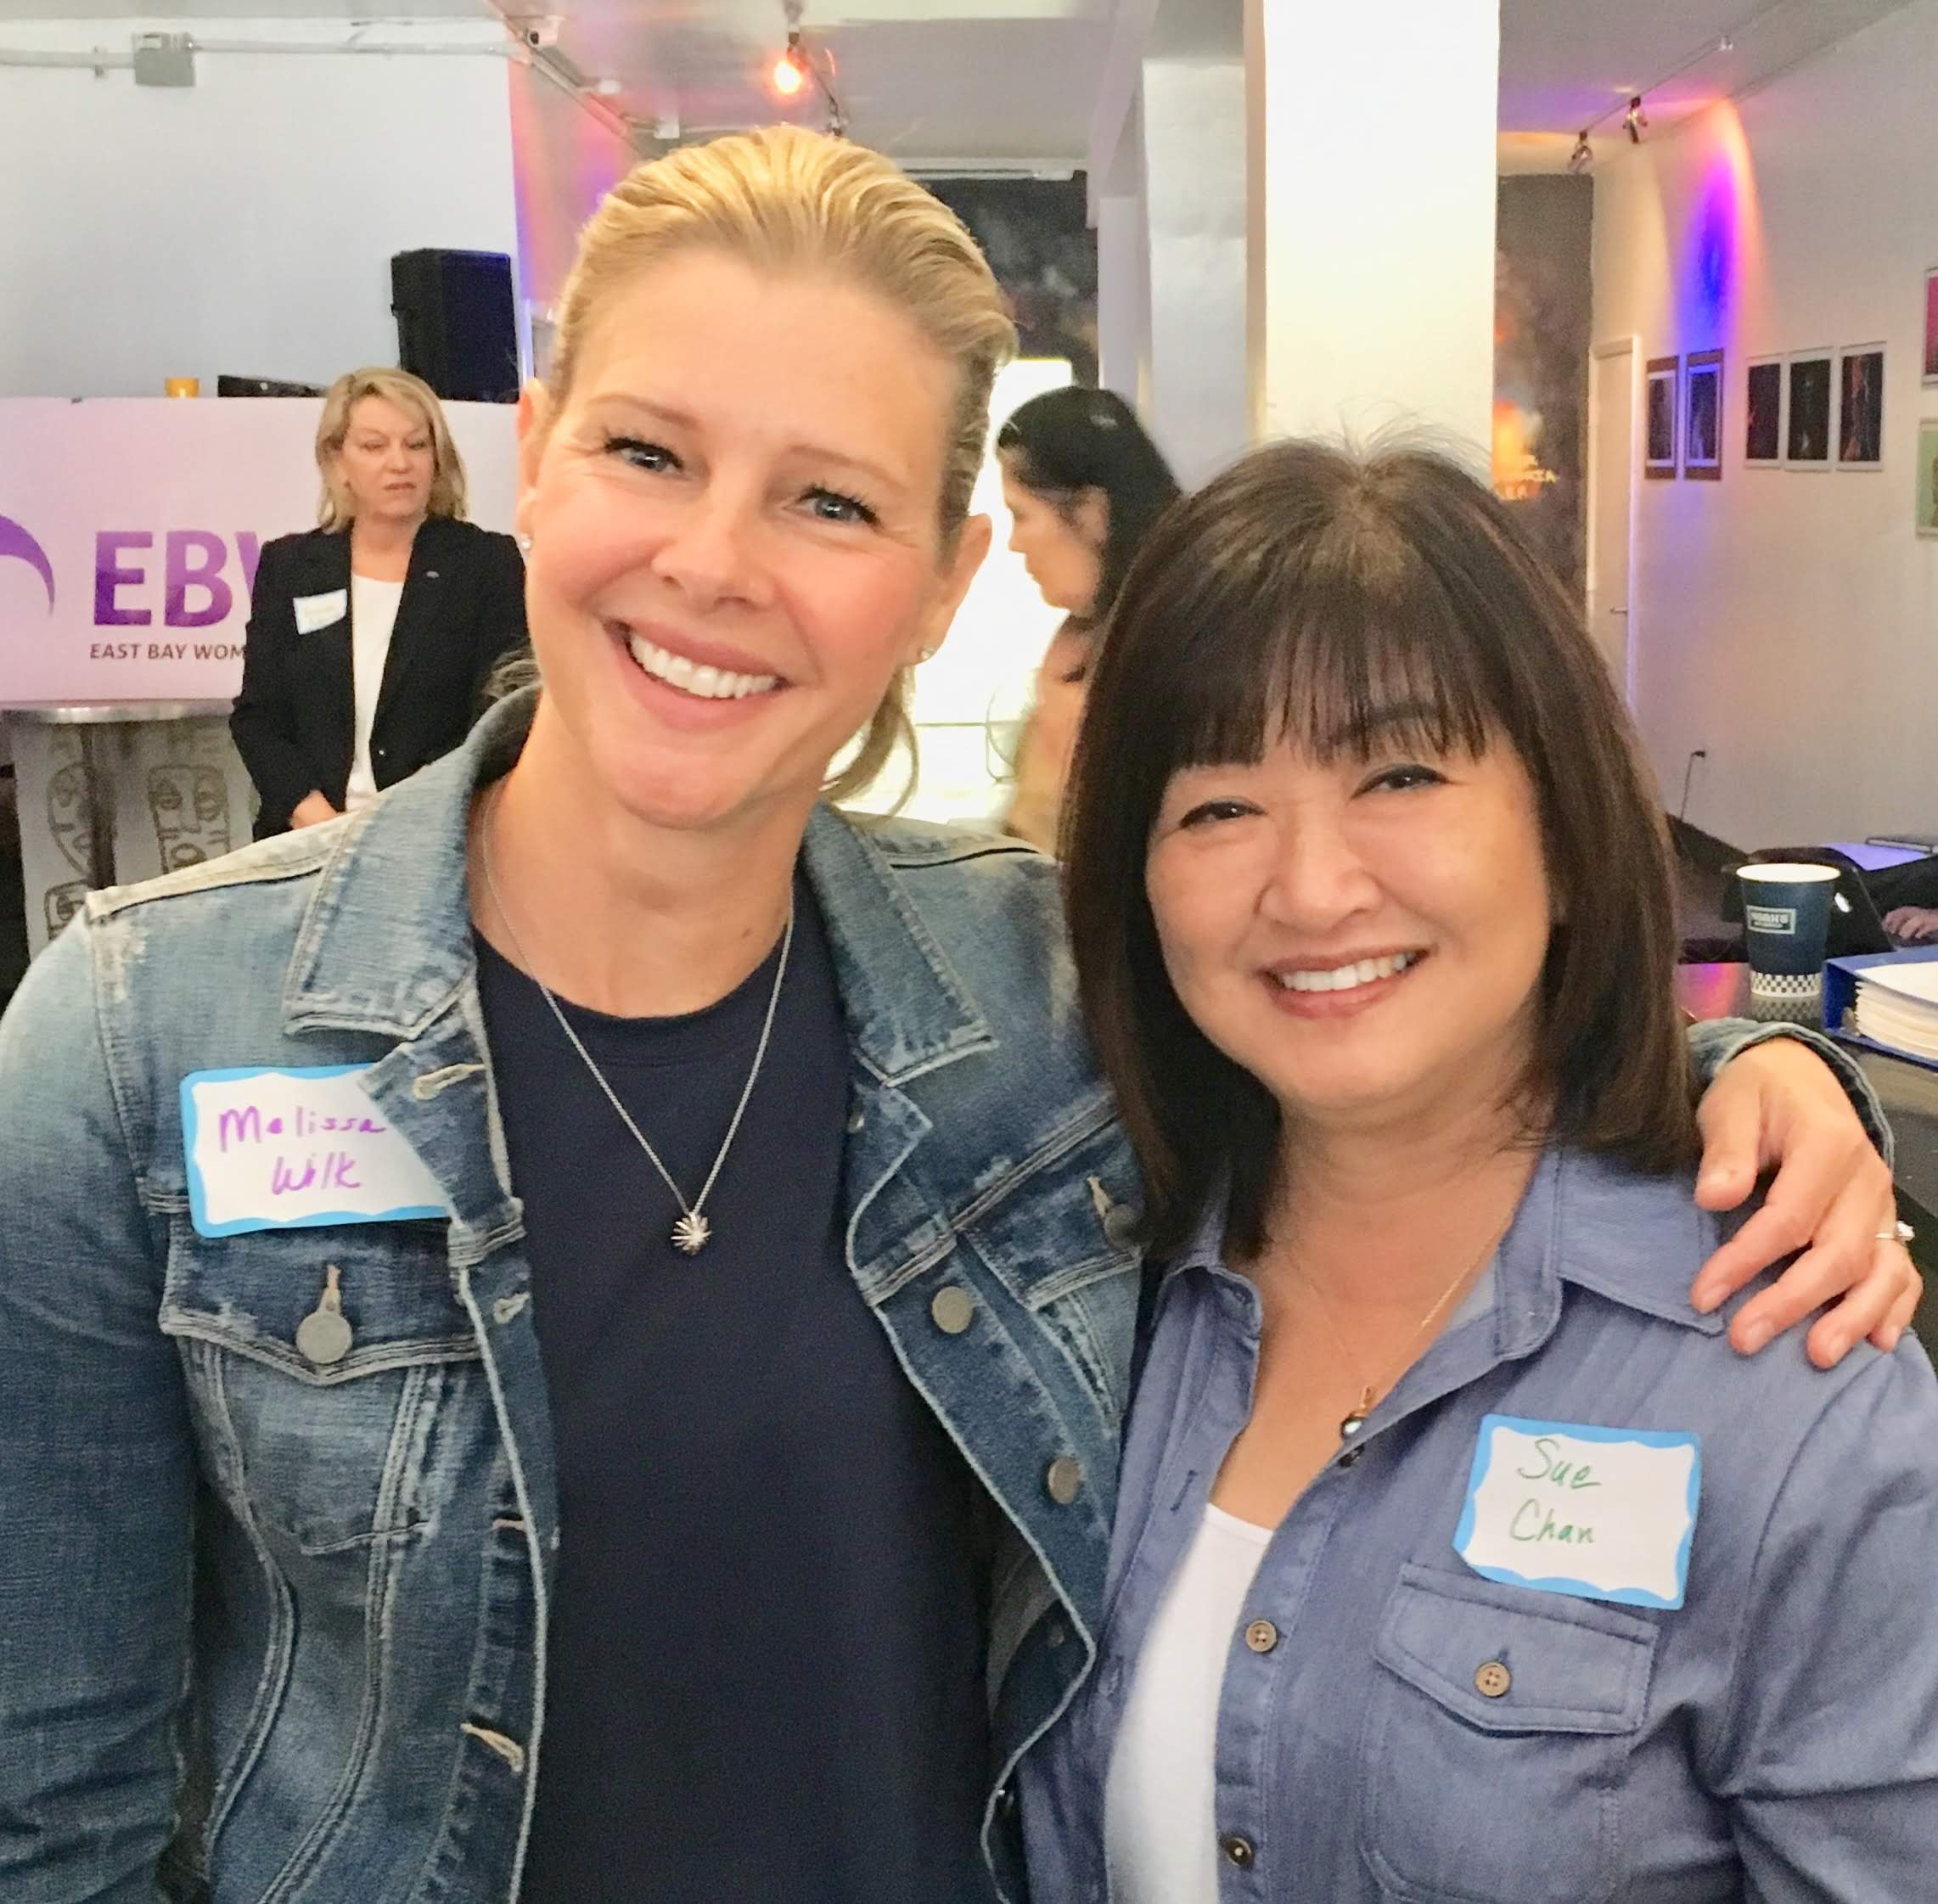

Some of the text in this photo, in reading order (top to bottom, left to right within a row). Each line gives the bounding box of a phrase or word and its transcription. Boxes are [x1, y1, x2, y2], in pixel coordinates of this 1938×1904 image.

[90, 643, 141, 660] EAST
[148, 643, 187, 660] BAY
[218, 1105, 386, 1153] Melissa
[271, 1151, 362, 1196] Wilk
[1516, 1437, 1603, 1490] Sue
[1509, 1497, 1595, 1544] Chan
